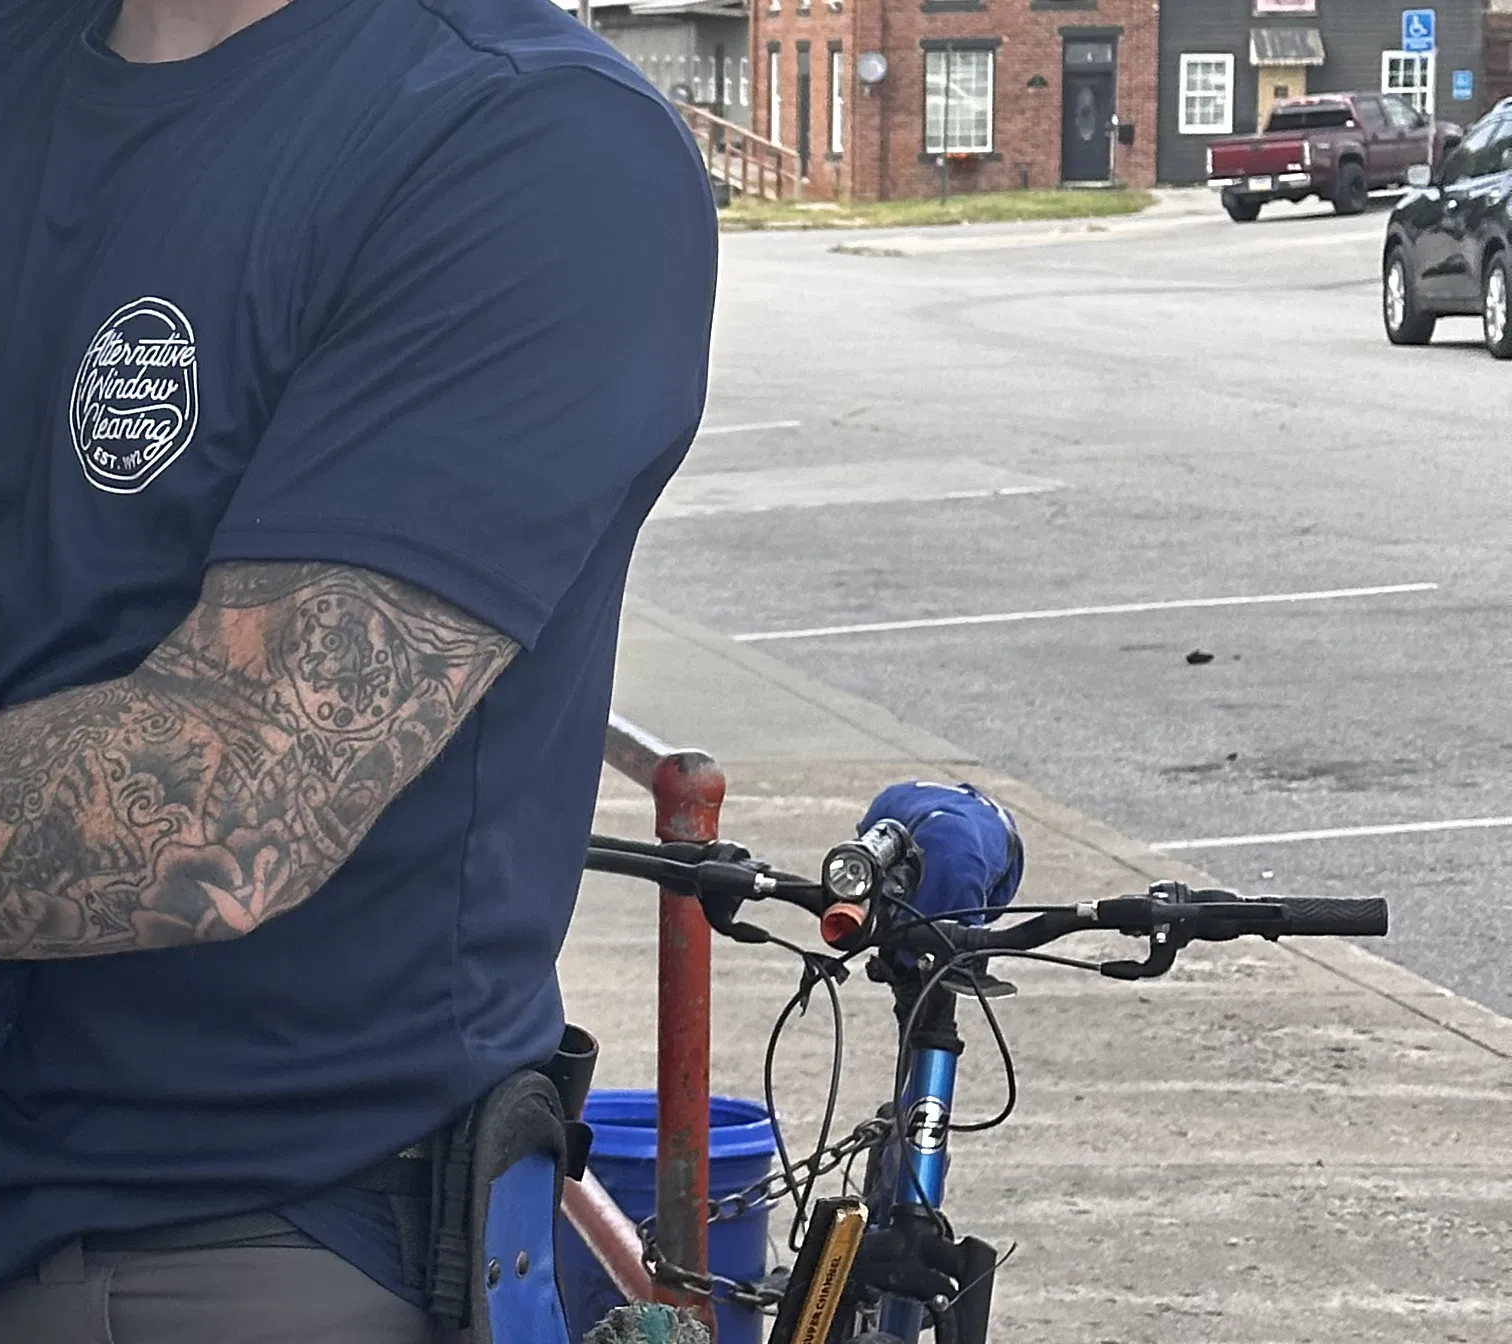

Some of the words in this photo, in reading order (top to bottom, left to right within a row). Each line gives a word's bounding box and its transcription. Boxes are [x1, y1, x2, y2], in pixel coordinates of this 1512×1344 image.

[90, 329, 195, 367] Alternative
[81, 366, 178, 404] Window
[81, 403, 178, 460] Cleaning
